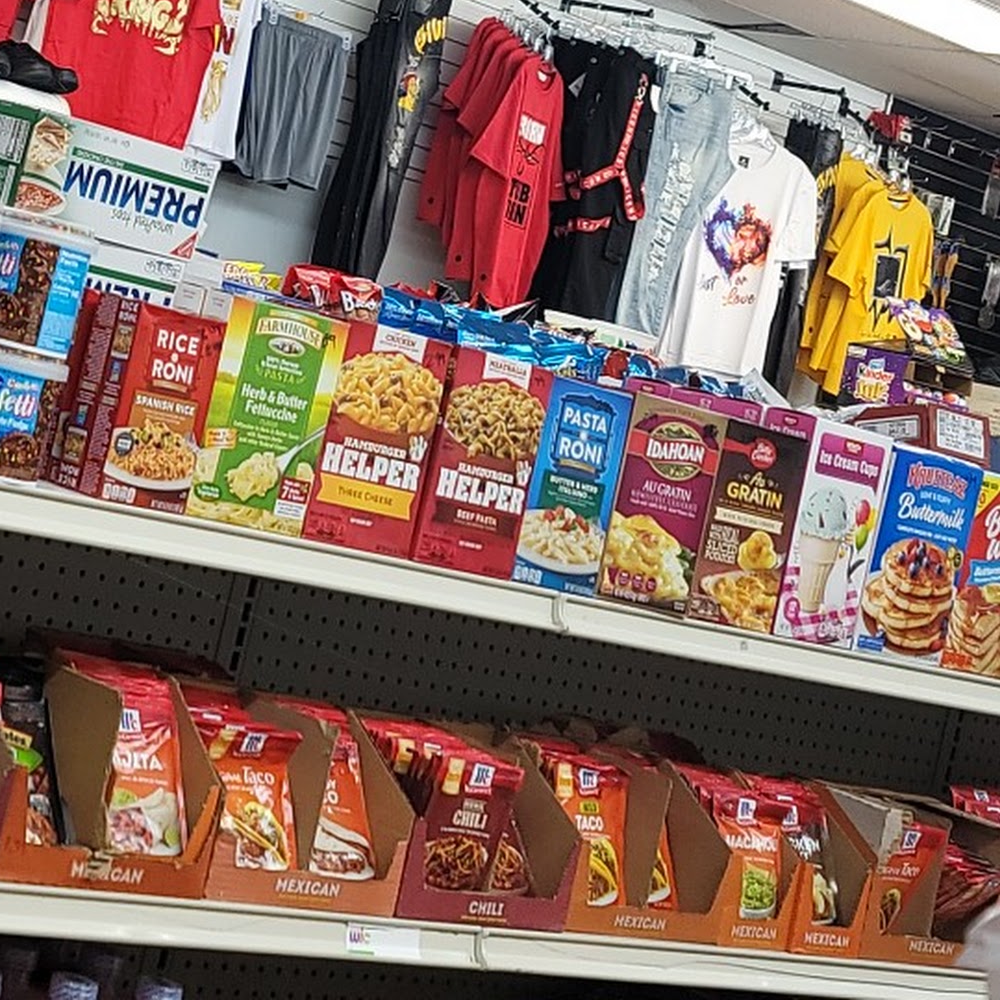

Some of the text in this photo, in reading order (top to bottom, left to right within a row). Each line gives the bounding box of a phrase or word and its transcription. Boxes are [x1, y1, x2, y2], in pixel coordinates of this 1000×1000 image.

[63, 161, 205, 229] PREMIUM
[156, 329, 199, 356] RICE
[258, 318, 321, 349] FARMHOUSE
[151, 359, 194, 386] RONI
[264, 368, 294, 385] PASTA
[135, 394, 195, 416] SPANISH RICE
[241, 383, 308, 412] Herb & Butter
[244, 400, 298, 424] Fettuccine
[563, 406, 607, 434] PASTA
[344, 436, 407, 460] HAMBURGER
[559, 436, 603, 465] RONI
[646, 438, 705, 465] IDAHOAN
[321, 442, 420, 492] HELPER
[458, 463, 515, 485] HAMBURGER
[819, 450, 879, 478] Ice Cream Cups
[436, 467, 525, 515] HELPER
[550, 475, 576, 488] BUTTER
[642, 479, 692, 501] AU GRATIN
[338, 485, 393, 506] THREE CHEESE
[727, 481, 783, 510] GRATIN
[456, 508, 498, 527] BEEF PASTA
[898, 492, 965, 531] Buttermilk
[242, 766, 275, 786] Taco
[453, 809, 488, 829] CHILI
[575, 815, 604, 831] TACO
[276, 877, 340, 897] MEXICAN
[469, 900, 504, 916] CHILI
[614, 914, 666, 931] MEXICAN
[731, 924, 777, 940] MEXICAN
[804, 931, 849, 947] MEXICAN
[908, 939, 955, 956] MEXICAN
